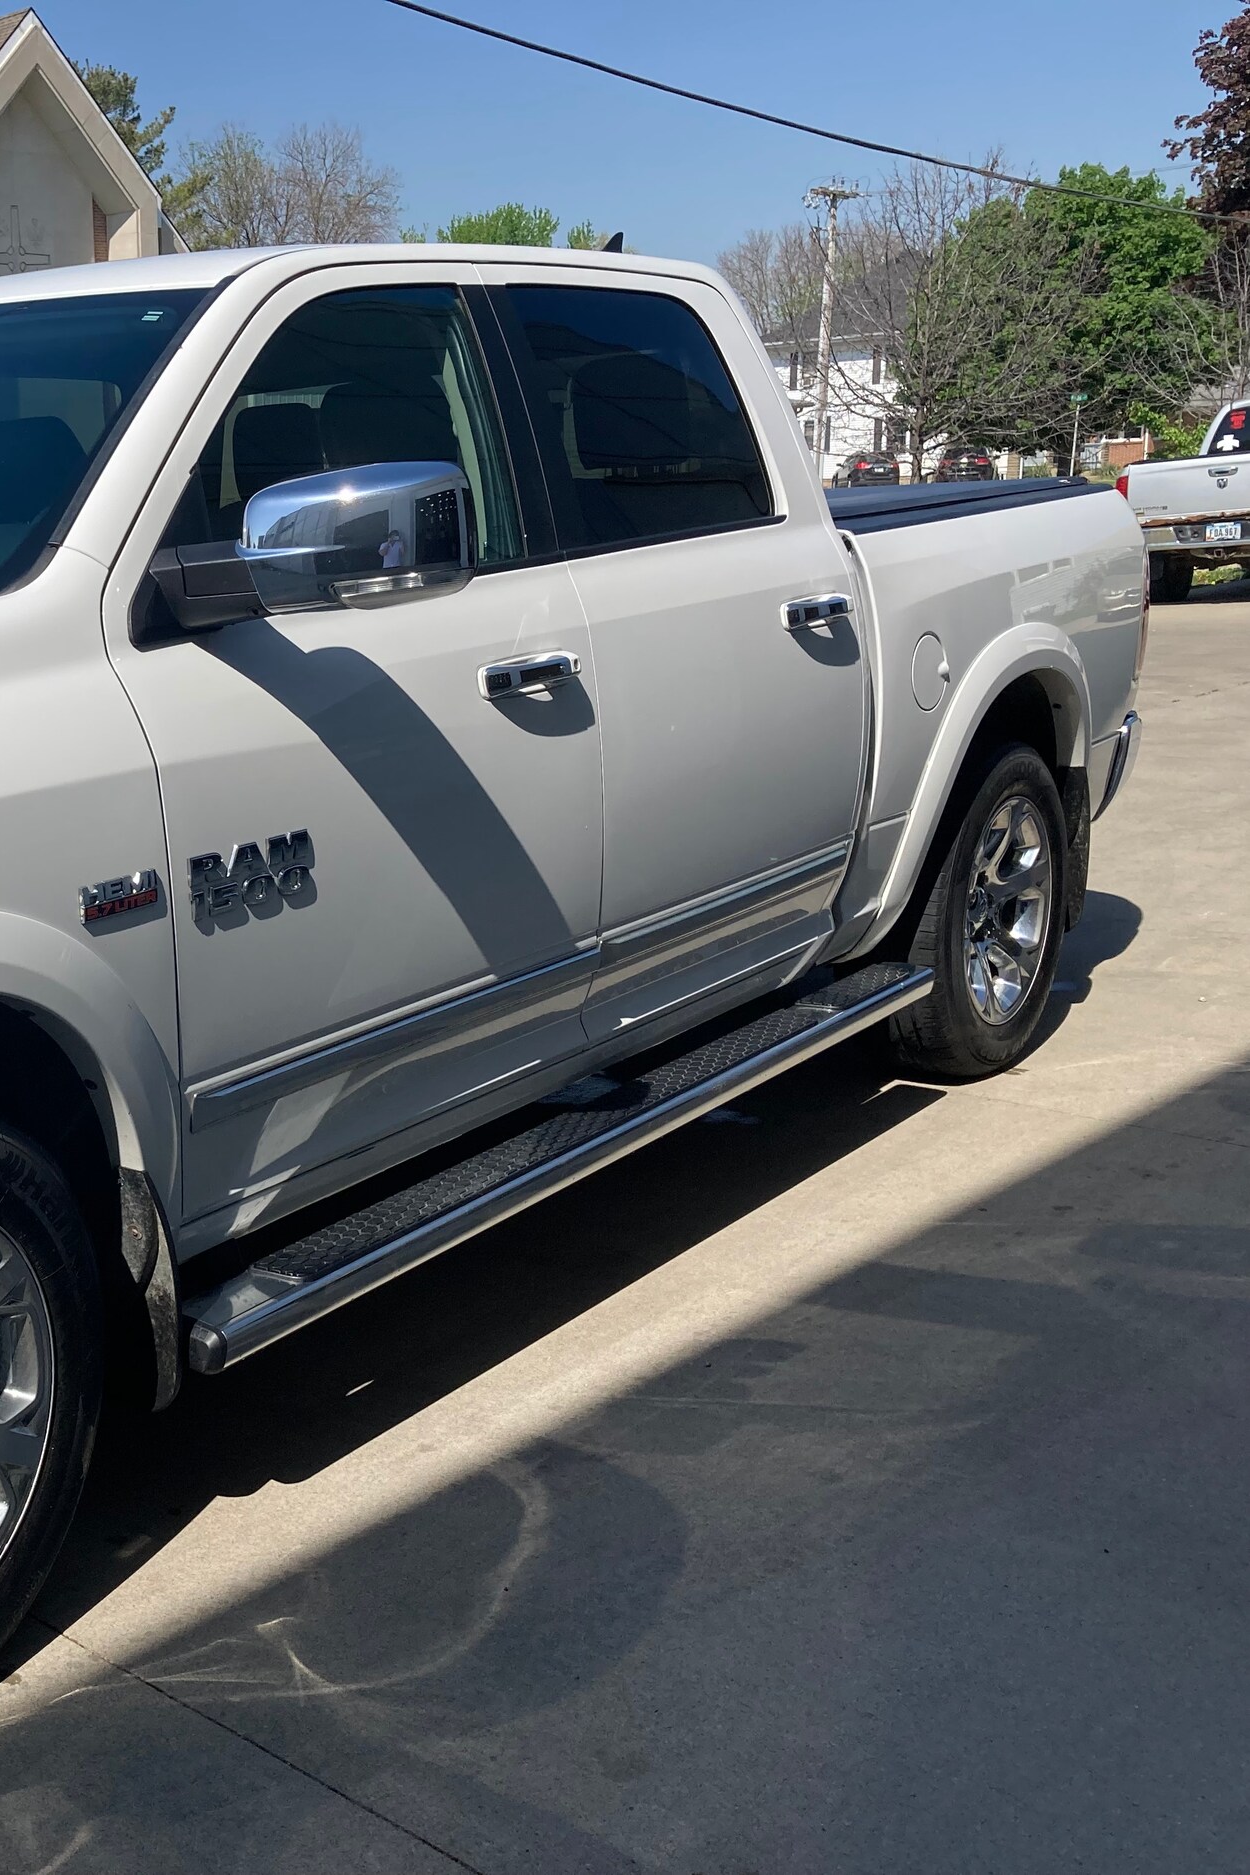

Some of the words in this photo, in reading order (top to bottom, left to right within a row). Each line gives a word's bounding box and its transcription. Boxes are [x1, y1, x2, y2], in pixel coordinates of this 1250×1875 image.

[187, 829, 310, 889] RAM
[78, 869, 156, 907] HEMI
[113, 889, 157, 912] LITER
[189, 865, 312, 921] 1500
